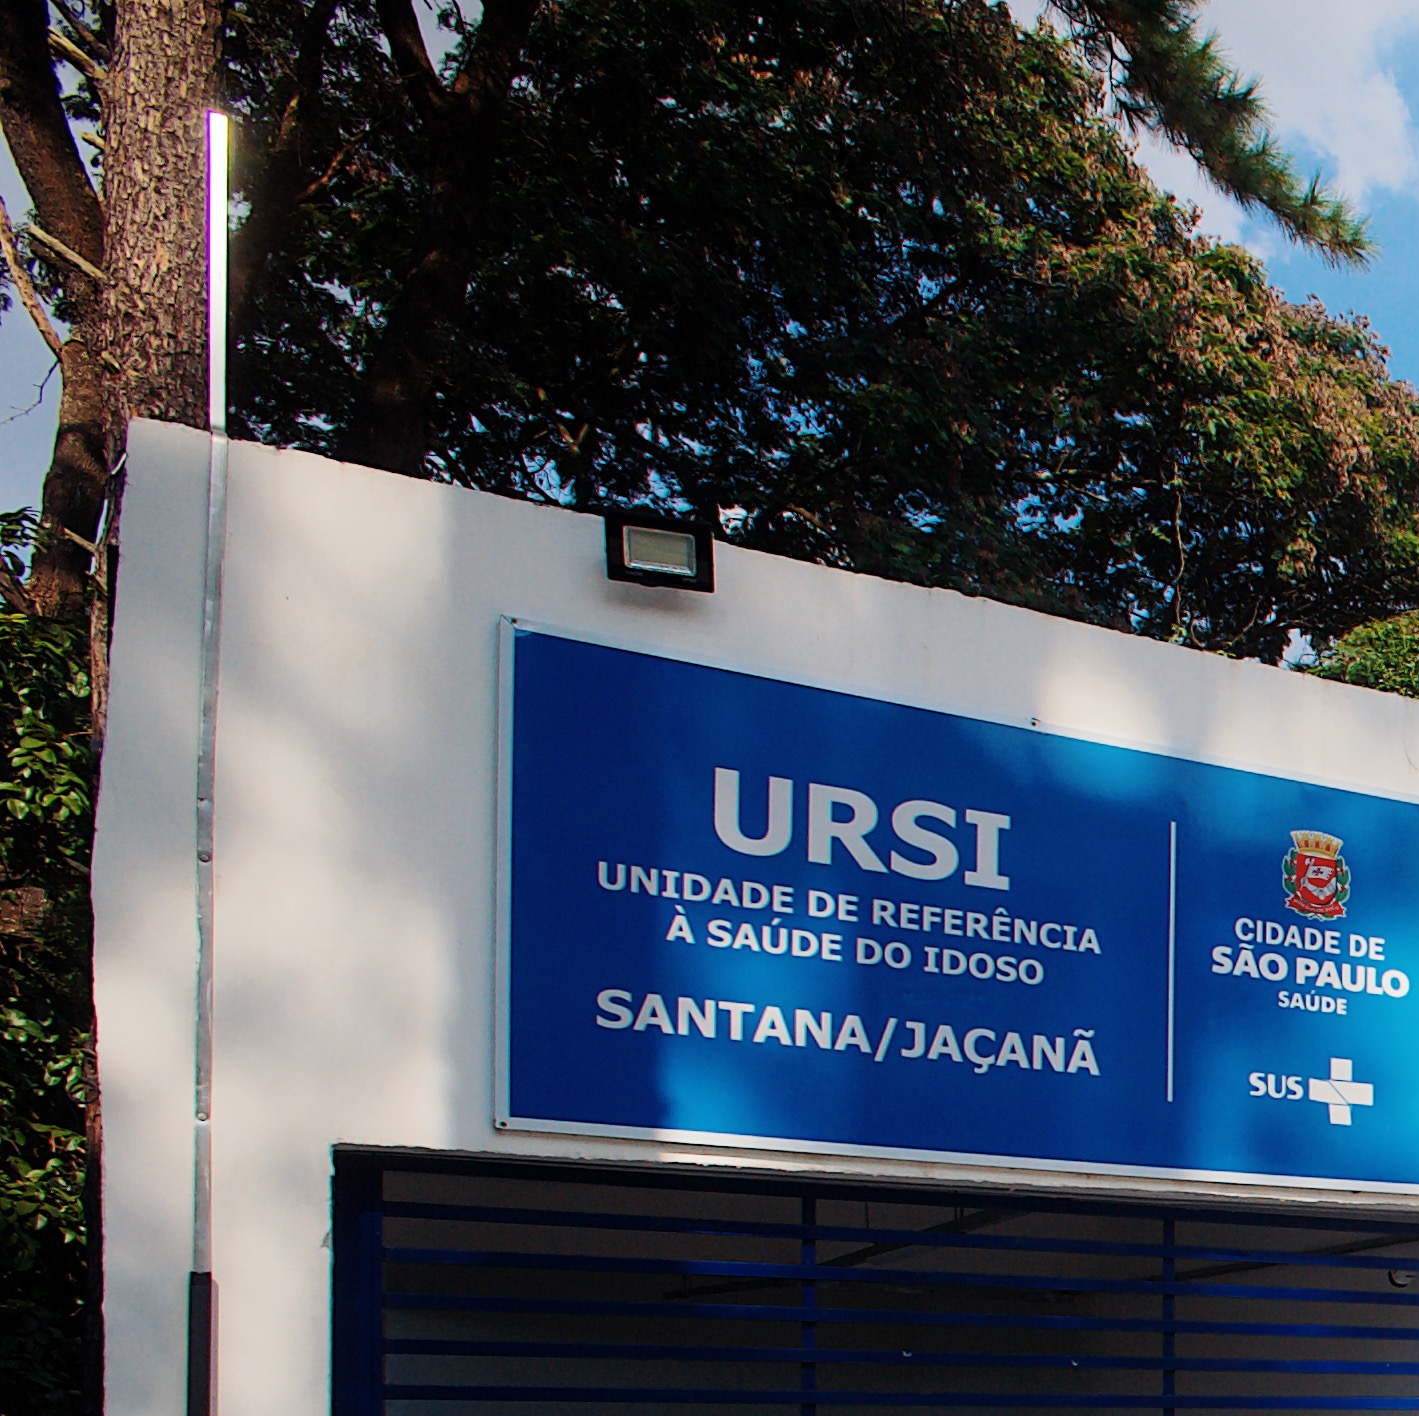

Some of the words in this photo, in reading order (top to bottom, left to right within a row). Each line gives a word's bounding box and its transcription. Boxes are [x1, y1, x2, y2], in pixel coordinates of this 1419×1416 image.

[714, 767, 1012, 890] URSI
[597, 860, 797, 914] UNIDADE
[807, 888, 859, 922] DE
[871, 897, 1102, 956] REFERÊNCIA
[1234, 916, 1339, 956] CIDADE
[1348, 933, 1386, 961] DE
[665, 904, 695, 944] À
[705, 909, 844, 962] SAÚDE
[855, 937, 912, 970] DO
[922, 944, 1045, 986] IDOSO
[1211, 938, 1290, 979] SÃO
[1295, 956, 1411, 999] PAULO
[1277, 988, 1348, 1016] SAÚDE
[1247, 1070, 1305, 1101] SUS
